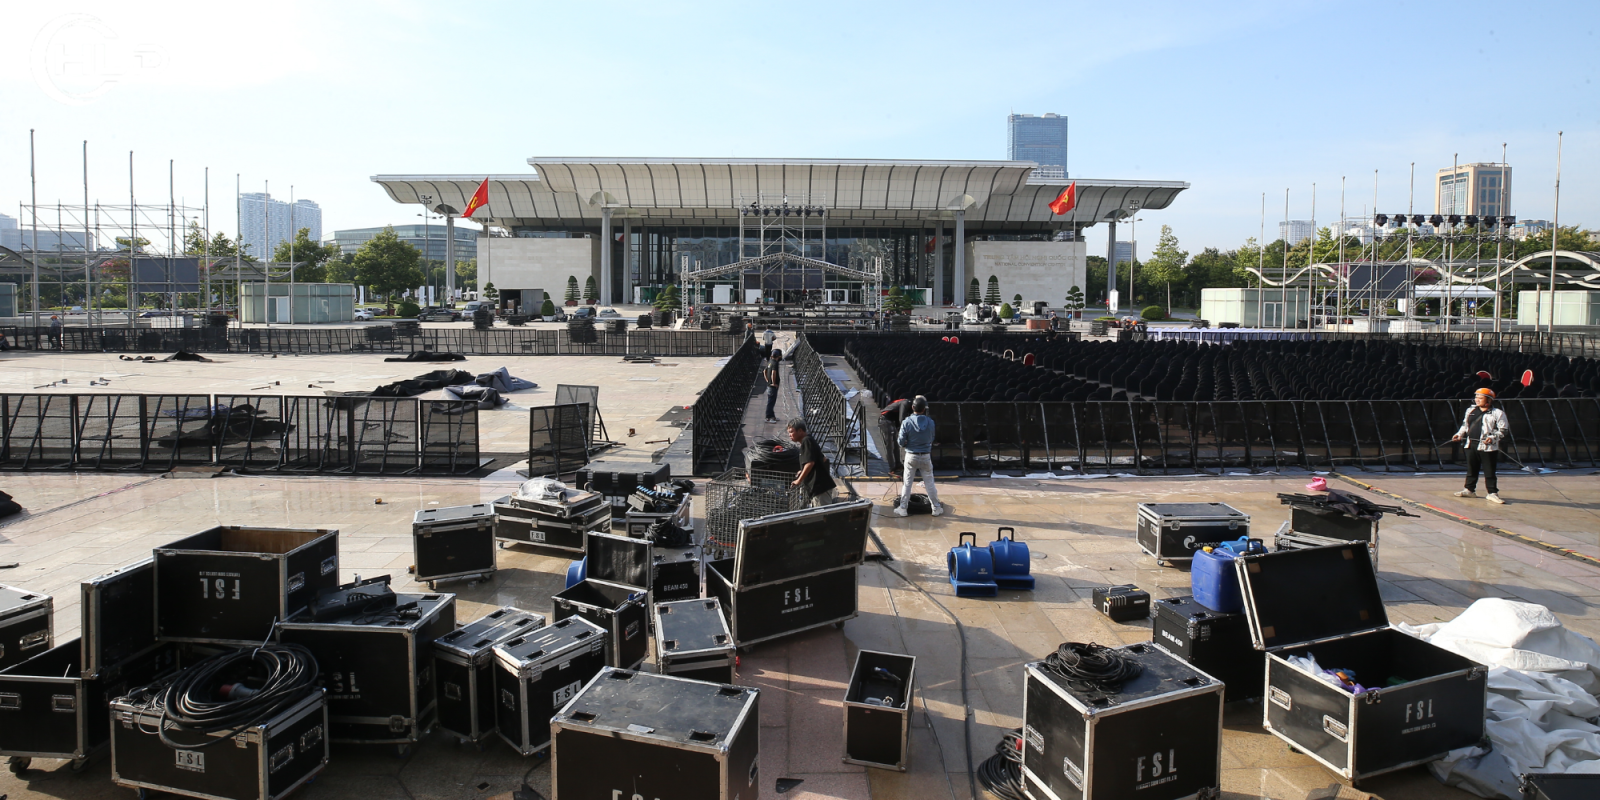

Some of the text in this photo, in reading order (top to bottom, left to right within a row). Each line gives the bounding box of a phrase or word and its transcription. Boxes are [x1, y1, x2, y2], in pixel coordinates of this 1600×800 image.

[200, 578, 240, 600] FSL
[663, 584, 679, 592] BEAM
[784, 586, 811, 606] FSL
[1405, 698, 1434, 723] FSL
[178, 751, 203, 766] FSL
[1136, 748, 1177, 782] FSL
